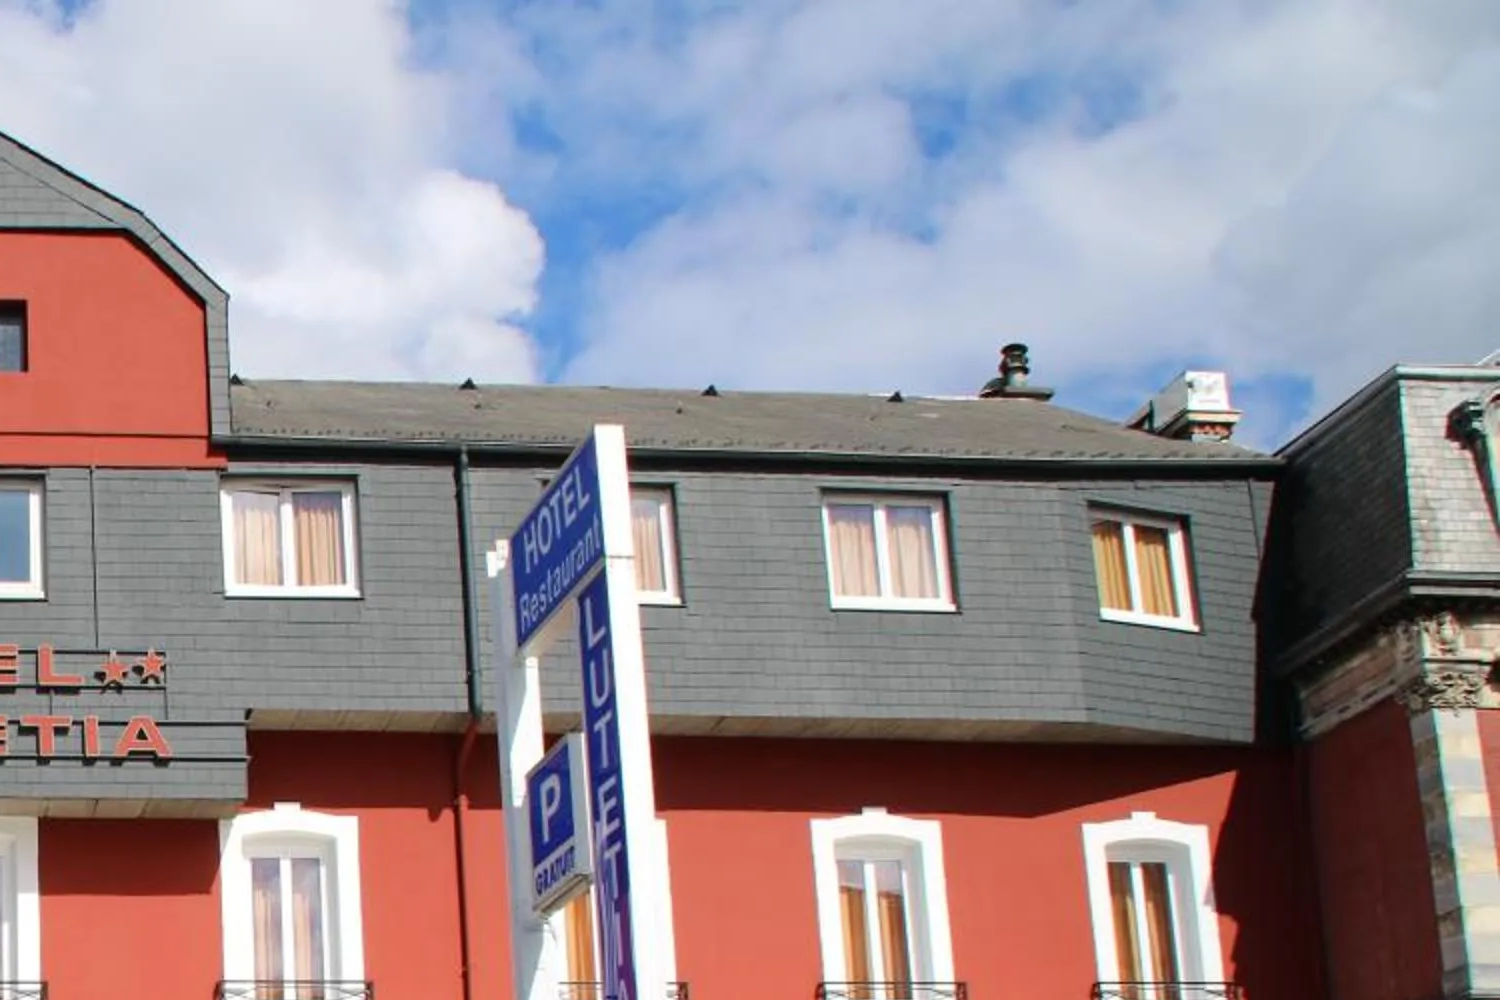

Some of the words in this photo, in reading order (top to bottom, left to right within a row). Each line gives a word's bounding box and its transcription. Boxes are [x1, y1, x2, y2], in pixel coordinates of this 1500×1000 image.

[523, 465, 590, 574] HOTEL
[520, 512, 601, 633] Restaurant
[539, 773, 561, 843] P
[535, 845, 575, 896] GRATUIT
